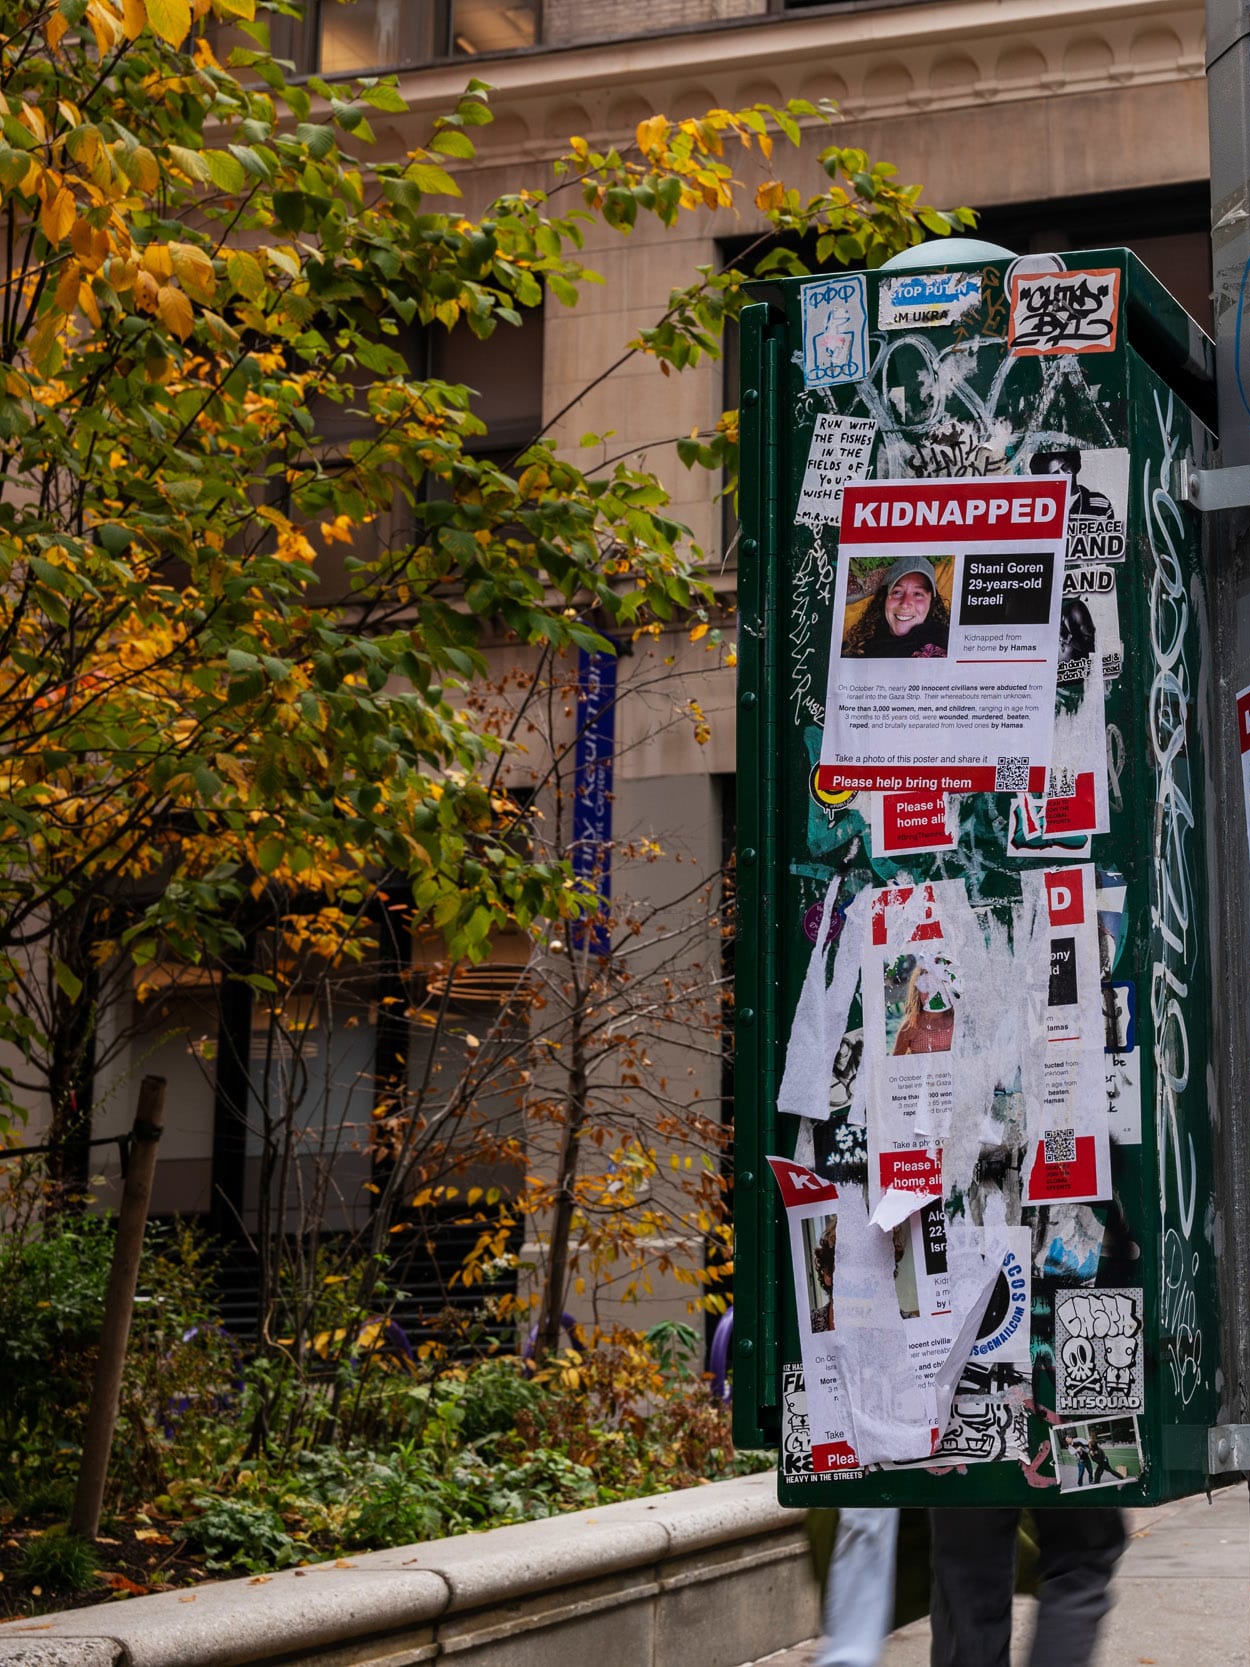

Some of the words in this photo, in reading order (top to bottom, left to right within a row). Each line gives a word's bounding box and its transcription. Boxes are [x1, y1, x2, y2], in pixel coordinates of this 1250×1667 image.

[820, 418, 842, 430] RUN
[850, 421, 876, 431] WITH
[814, 434, 834, 444] THE
[840, 433, 872, 446] FISHES
[822, 448, 834, 457] IN
[840, 448, 863, 458] THE
[807, 460, 841, 471] FIELDS
[848, 462, 864, 473] OF
[853, 497, 1057, 528] KIDNAPPED
[1079, 521, 1122, 534] PEACE
[970, 563, 1004, 574] Shani
[1007, 562, 1044, 574] Goren
[968, 578, 1042, 592] 29-years-old
[967, 594, 1004, 605] Israeli
[964, 633, 1004, 642] Kidnapped
[963, 644, 975, 652] her
[977, 644, 997, 652] home
[999, 644, 1008, 653] by
[979, 705, 1003, 713] ranging
[835, 754, 854, 763] Take
[863, 754, 885, 764] photo
[887, 754, 896, 763] of
[897, 754, 911, 763] this
[913, 755, 939, 765] poster
[941, 755, 956, 764] and
[958, 755, 980, 764] share
[982, 754, 988, 764] it
[832, 776, 872, 788] Please
[876, 776, 903, 790] help
[905, 776, 937, 791] bring
[941, 777, 972, 788] them
[897, 801, 934, 813] Please
[897, 816, 928, 828] home
[1113, 1055, 1127, 1067] be
[892, 1141, 909, 1149] Take
[893, 1160, 930, 1172] Please
[894, 1175, 925, 1188] home
[820, 1377, 837, 1385] More
[1060, 1395, 1141, 1410] HITSQUAD
[825, 1430, 844, 1440] Take
[786, 1475, 809, 1484] HEAVY
[811, 1474, 818, 1482] IN
[820, 1473, 832, 1481] THE
[833, 1471, 863, 1480] STREETS
